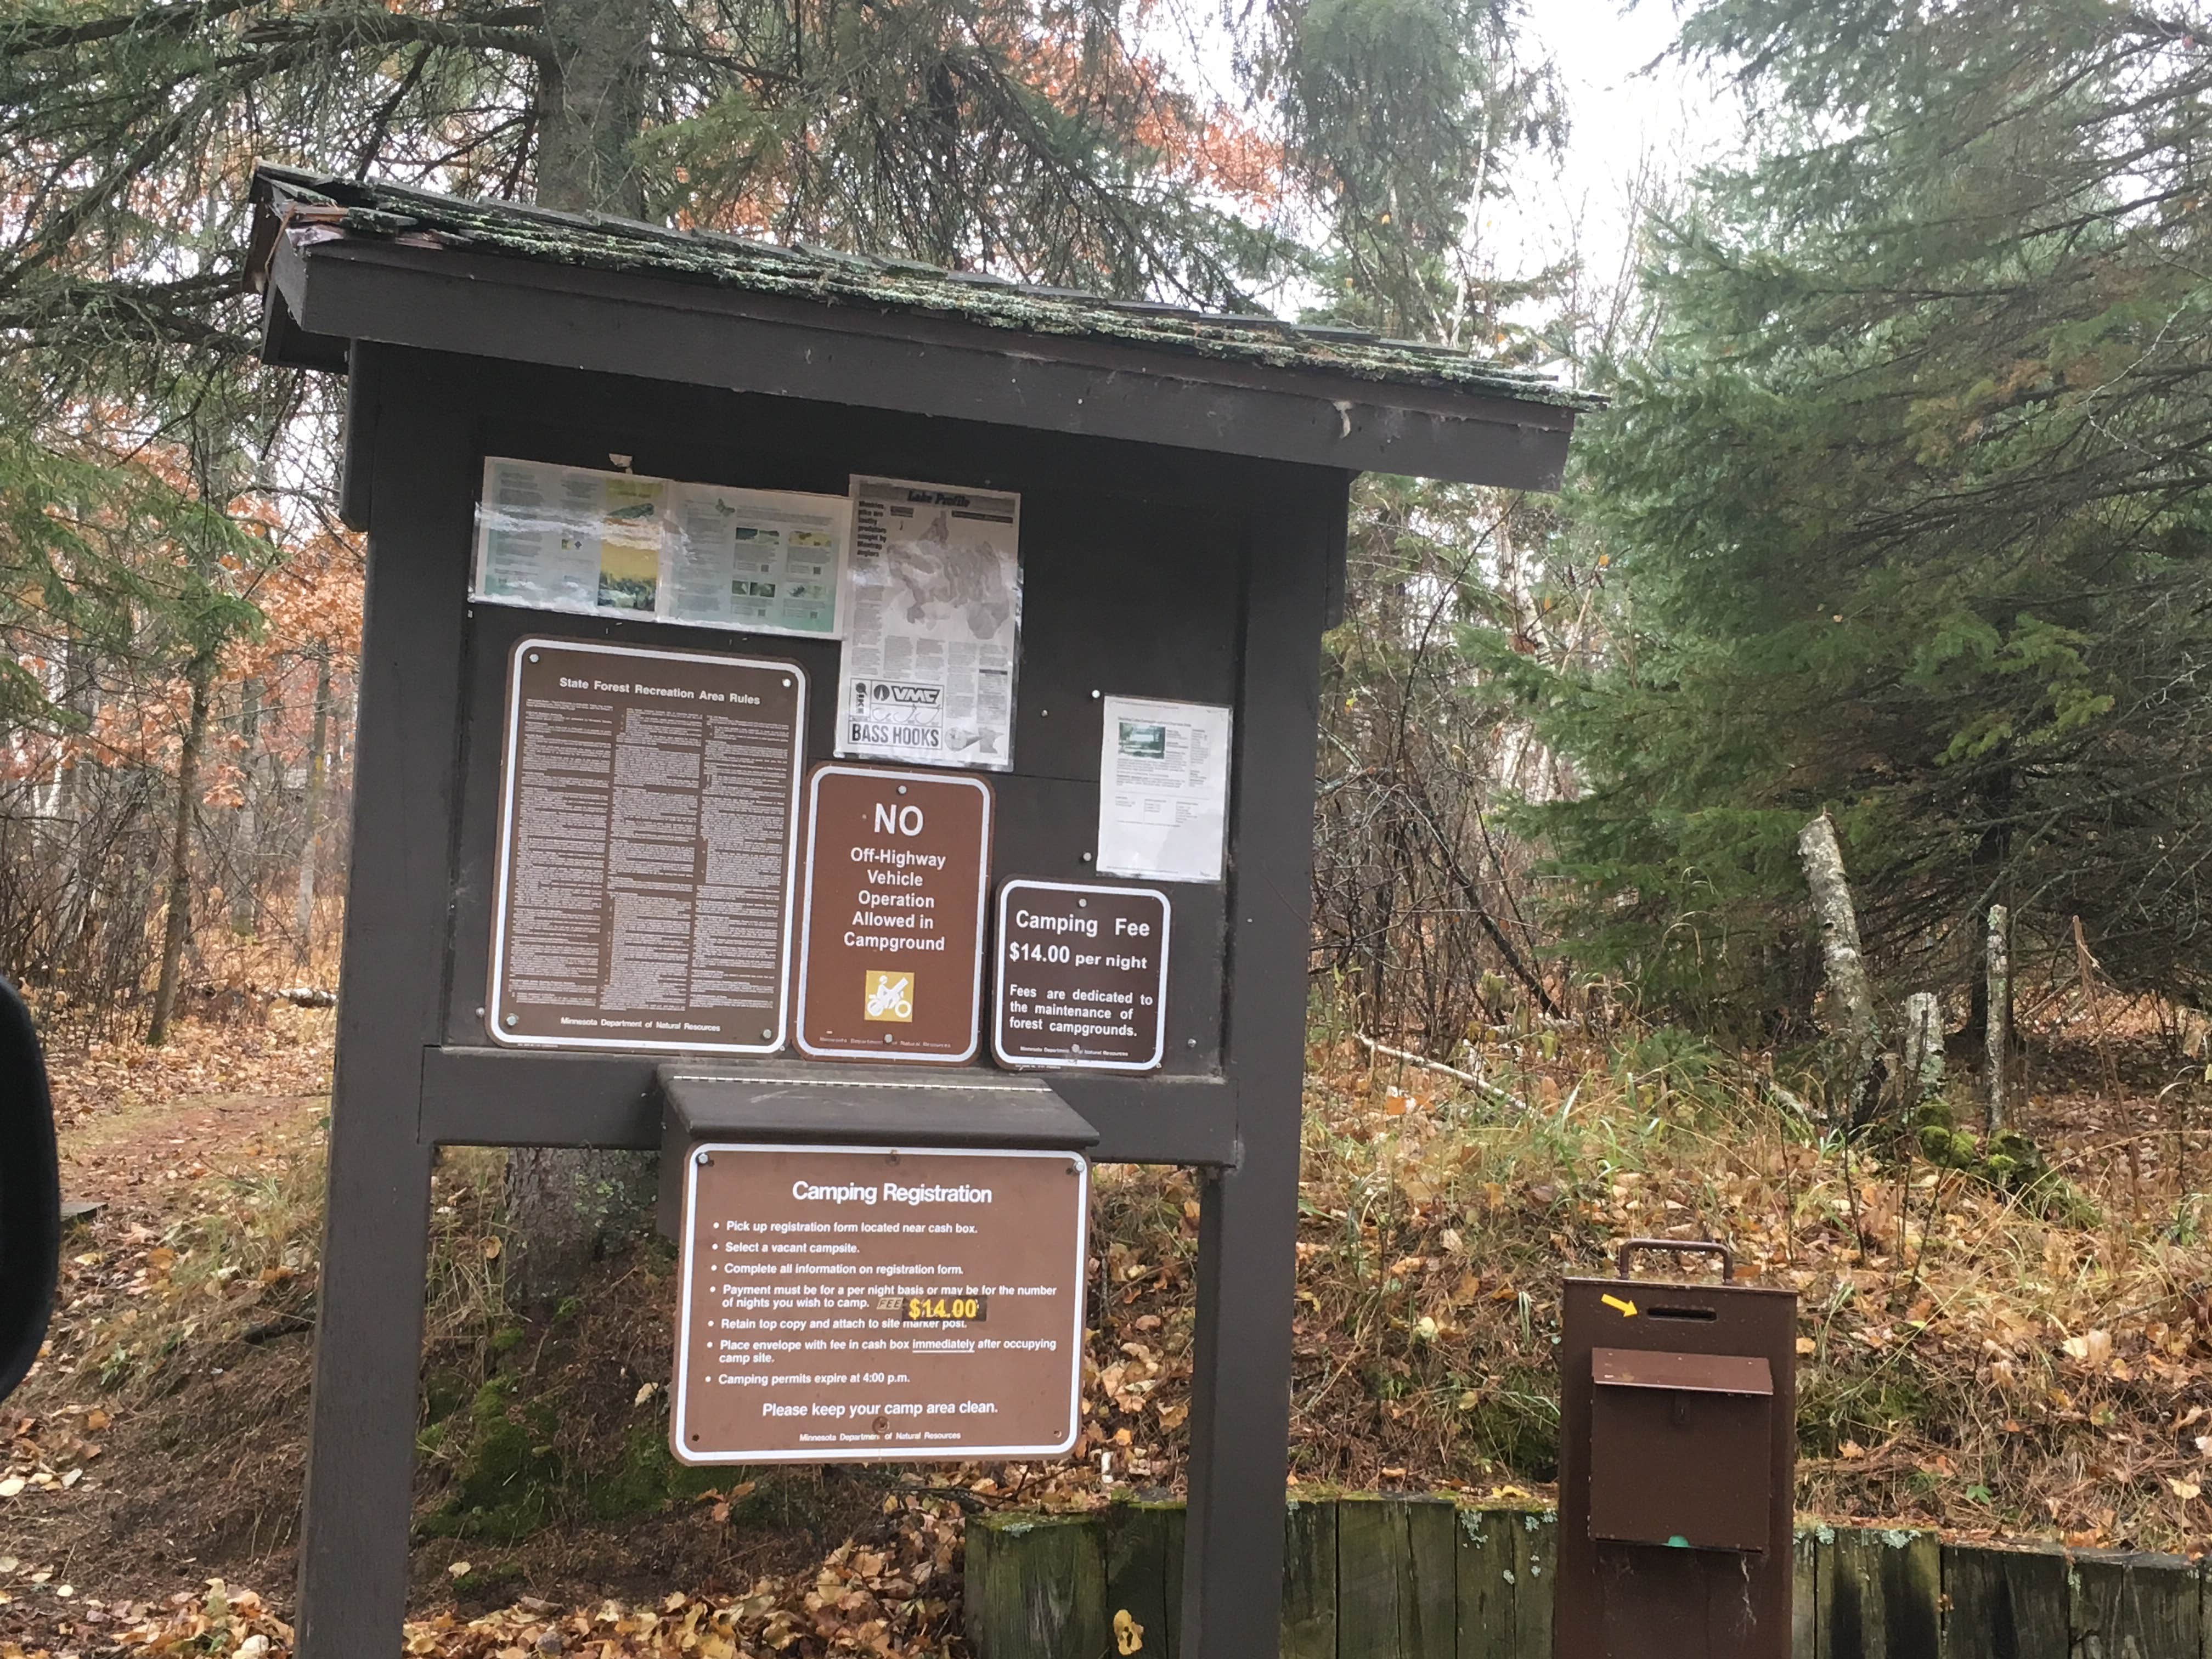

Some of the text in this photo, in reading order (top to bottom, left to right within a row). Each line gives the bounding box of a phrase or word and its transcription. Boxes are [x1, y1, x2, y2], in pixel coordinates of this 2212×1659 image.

[560, 678, 760, 704] State Forest Recreation Area Rules
[891, 686, 940, 704] VMC
[852, 723, 939, 747] BASS HOOKS
[874, 803, 923, 836] NO
[851, 848, 946, 870] Off-Highway
[867, 870, 922, 886] Vehicle
[859, 890, 934, 908] Operation
[853, 911, 933, 929] Allowed in
[1017, 910, 1149, 937] Camping Fee
[844, 932, 944, 951] Campground
[1010, 941, 1147, 970] $14.00 per night
[1010, 984, 1153, 1005] Fees are dedicated to
[1011, 1001, 1133, 1019] the maintenance of
[561, 1017, 597, 1025] Minnesota
[601, 1019, 642, 1027] Department
[684, 1023, 720, 1031] Resources
[1009, 1017, 1137, 1036] forest campgrounds.
[793, 1181, 991, 1205] Camping Registration
[727, 1221, 749, 1231] Pick
[753, 1223, 767, 1233] up
[771, 1222, 830, 1233] registration
[834, 1222, 857, 1232] form
[861, 1222, 900, 1232] located
[928, 1223, 952, 1233] cash
[956, 1223, 977, 1233] box.
[726, 1242, 759, 1252] Select
[772, 1243, 806, 1252] vacant
[810, 1243, 859, 1255] campsite.
[724, 1263, 777, 1276] Complete
[780, 1263, 792, 1273] all
[795, 1264, 856, 1274] information
[876, 1265, 934, 1276] registration
[938, 1265, 963, 1274] form.
[724, 1284, 771, 1297] Payment
[774, 1285, 800, 1295] must
[804, 1285, 817, 1295] be
[821, 1285, 835, 1295] for
[848, 1287, 865, 1297] per
[868, 1285, 894, 1297] night
[898, 1285, 924, 1295] basis
[941, 1287, 963, 1295] may
[966, 1285, 978, 1295] be
[982, 1285, 996, 1295] for
[999, 1285, 1014, 1295] the
[1018, 1285, 1057, 1295] number
[722, 1297, 869, 1310] of nights you wish to camp.
[879, 1299, 902, 1308] FEE
[909, 1298, 977, 1320] $14.00
[721, 1319, 755, 1329] Retain
[759, 1319, 777, 1330] top
[780, 1321, 806, 1331] copy
[810, 1318, 830, 1328] and
[833, 1318, 865, 1328] attach
[869, 1319, 878, 1328] to
[882, 1318, 900, 1328] site
[943, 1321, 967, 1330] post.
[720, 1339, 1056, 1352] Place envelope with fee in cash box immediately after occupying
[719, 1352, 774, 1365] camp site.
[719, 1373, 910, 1386] Camping permits expire at 4:00 p.m.
[763, 1401, 997, 1418] Please keep your camp area clean.
